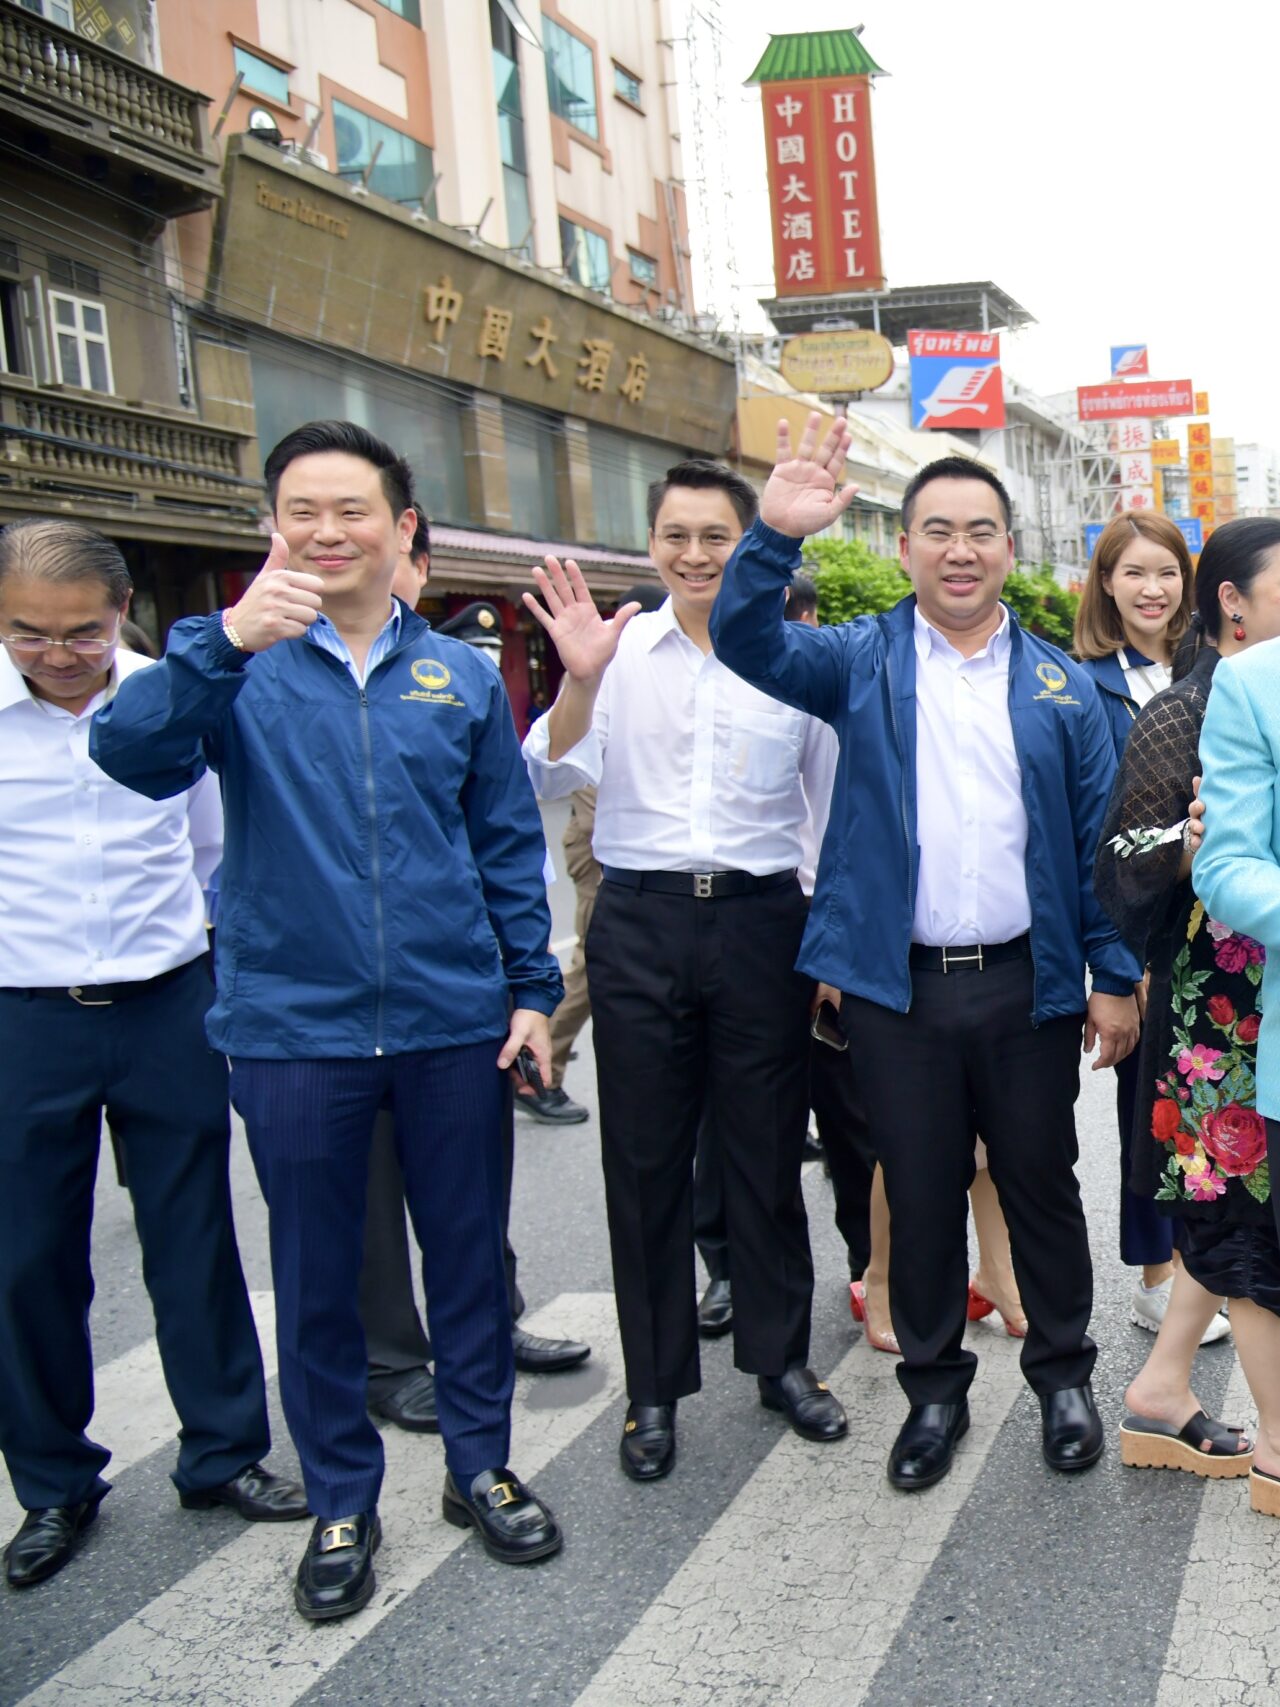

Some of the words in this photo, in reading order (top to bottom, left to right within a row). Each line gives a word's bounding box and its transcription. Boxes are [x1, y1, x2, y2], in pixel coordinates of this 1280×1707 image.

[775, 95, 815, 281] 中國大酒店
[832, 93, 864, 278] HOTEL
[424, 274, 650, 404] 中國大酒店
[913, 333, 994, 356] รุ่งทรัพย์
